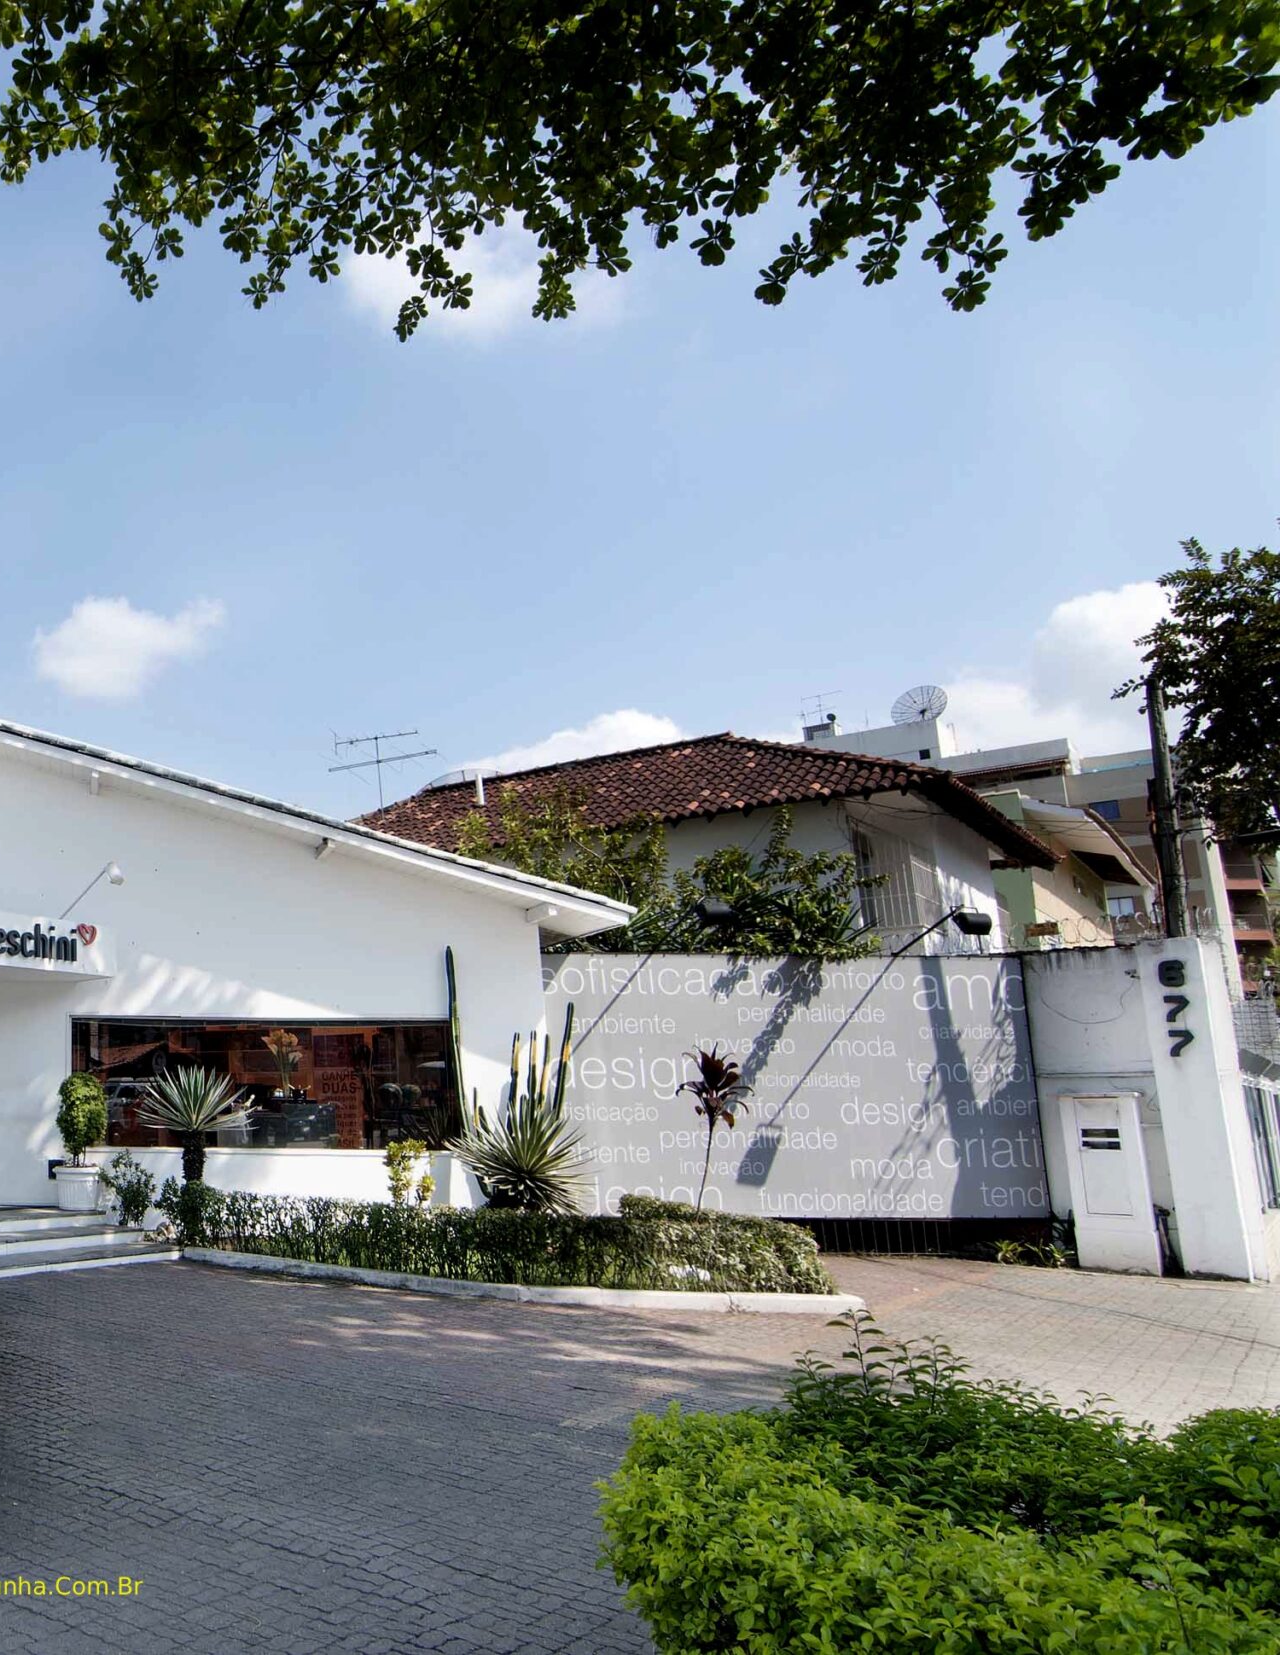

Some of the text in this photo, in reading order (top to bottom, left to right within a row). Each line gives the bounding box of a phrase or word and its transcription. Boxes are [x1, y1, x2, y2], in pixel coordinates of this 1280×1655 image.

[571, 1014, 676, 1034] ambiente
[737, 1002, 886, 1026] personalidade
[694, 1033, 796, 1057] inovação
[829, 1036, 897, 1057] moda
[322, 1082, 357, 1094] DUAS
[732, 1098, 810, 1120] onforto
[840, 1095, 948, 1132] design
[659, 1126, 838, 1152] personalidade
[679, 1156, 765, 1178] inovação
[850, 1153, 934, 1180] moda
[758, 1187, 944, 1212] funcionalidade
[979, 1182, 1046, 1208] tend
